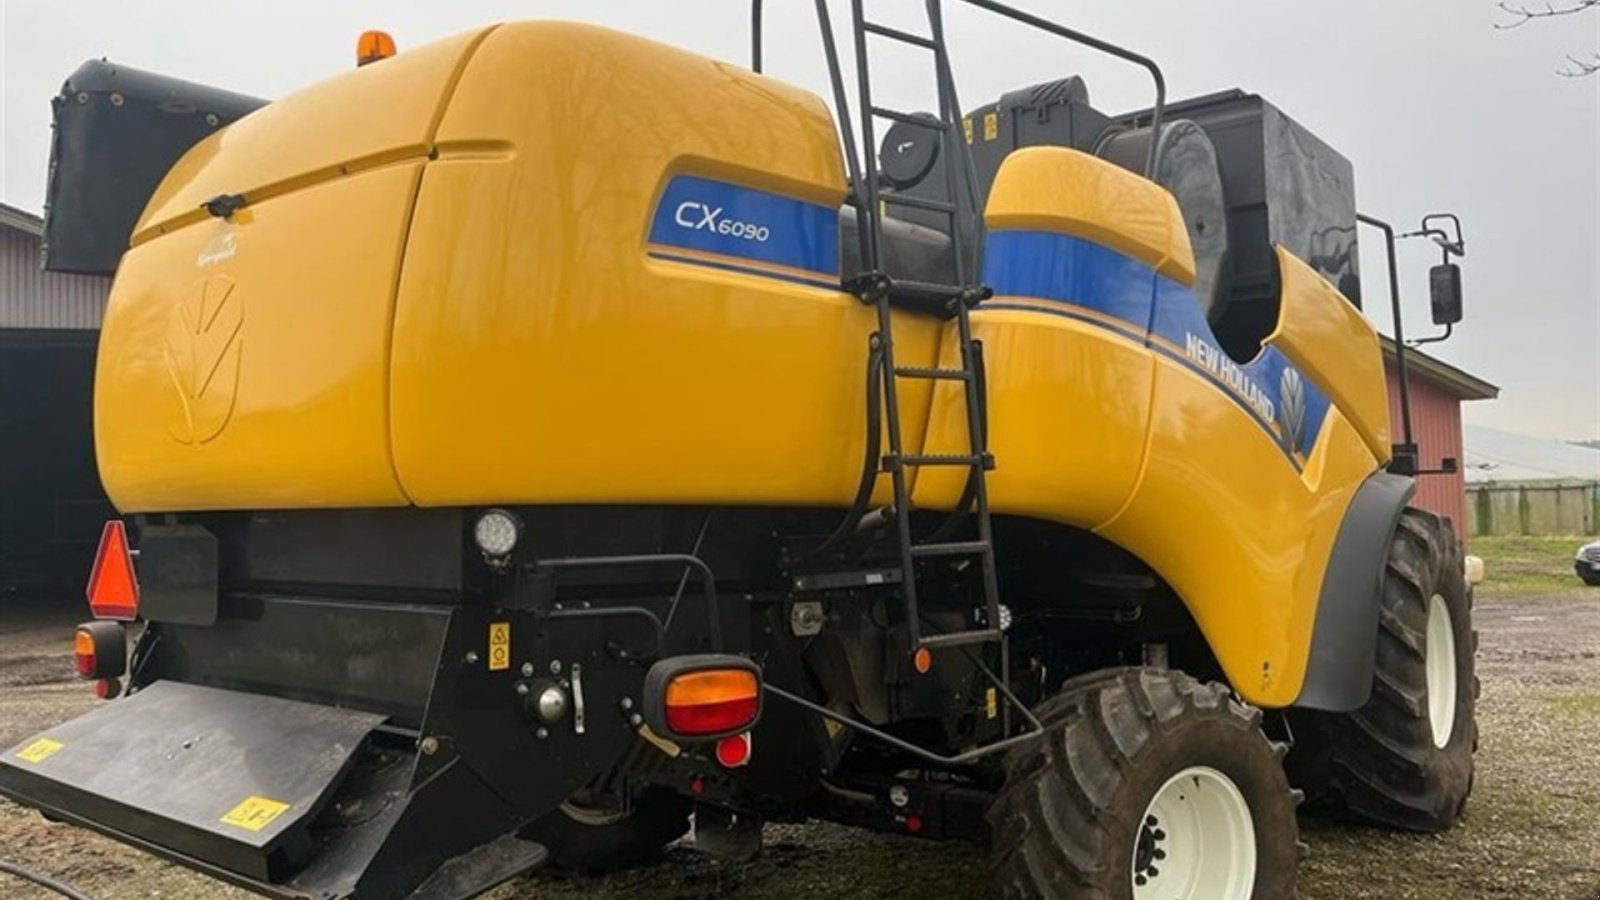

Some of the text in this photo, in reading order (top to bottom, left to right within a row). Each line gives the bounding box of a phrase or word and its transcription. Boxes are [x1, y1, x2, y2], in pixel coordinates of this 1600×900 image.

[675, 201, 769, 241] CX6090
[1186, 331, 1275, 423] NEW HOLLAND
